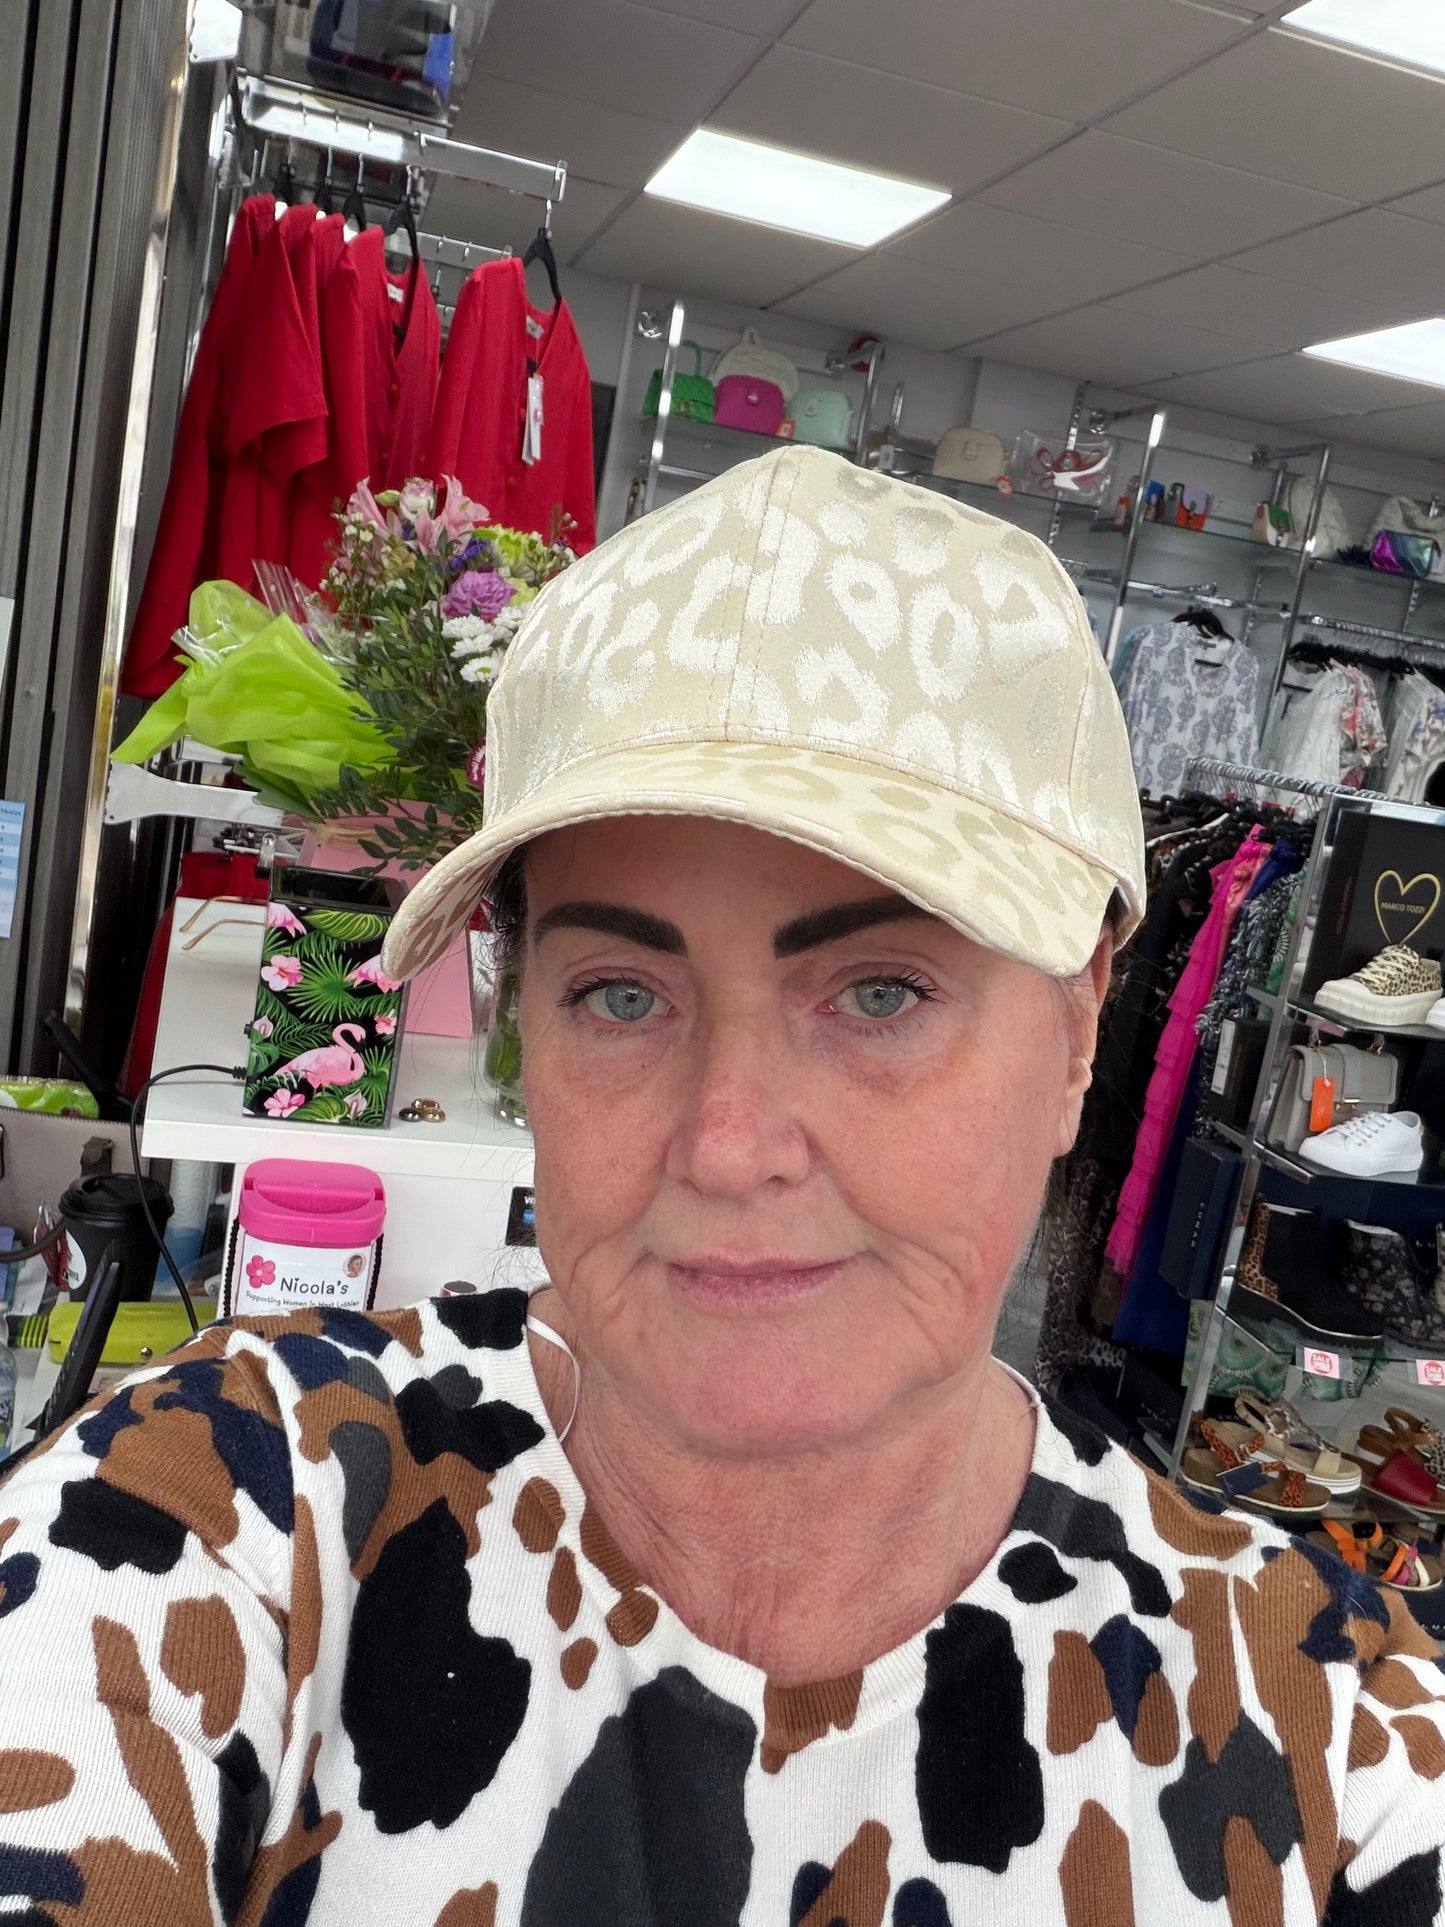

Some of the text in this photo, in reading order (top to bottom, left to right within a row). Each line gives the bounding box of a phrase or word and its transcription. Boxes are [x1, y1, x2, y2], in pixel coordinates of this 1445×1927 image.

[1380, 901, 1426, 914] MARCO TOZZI
[280, 1277, 349, 1295] Nicola's
[246, 1290, 281, 1306] Supporting
